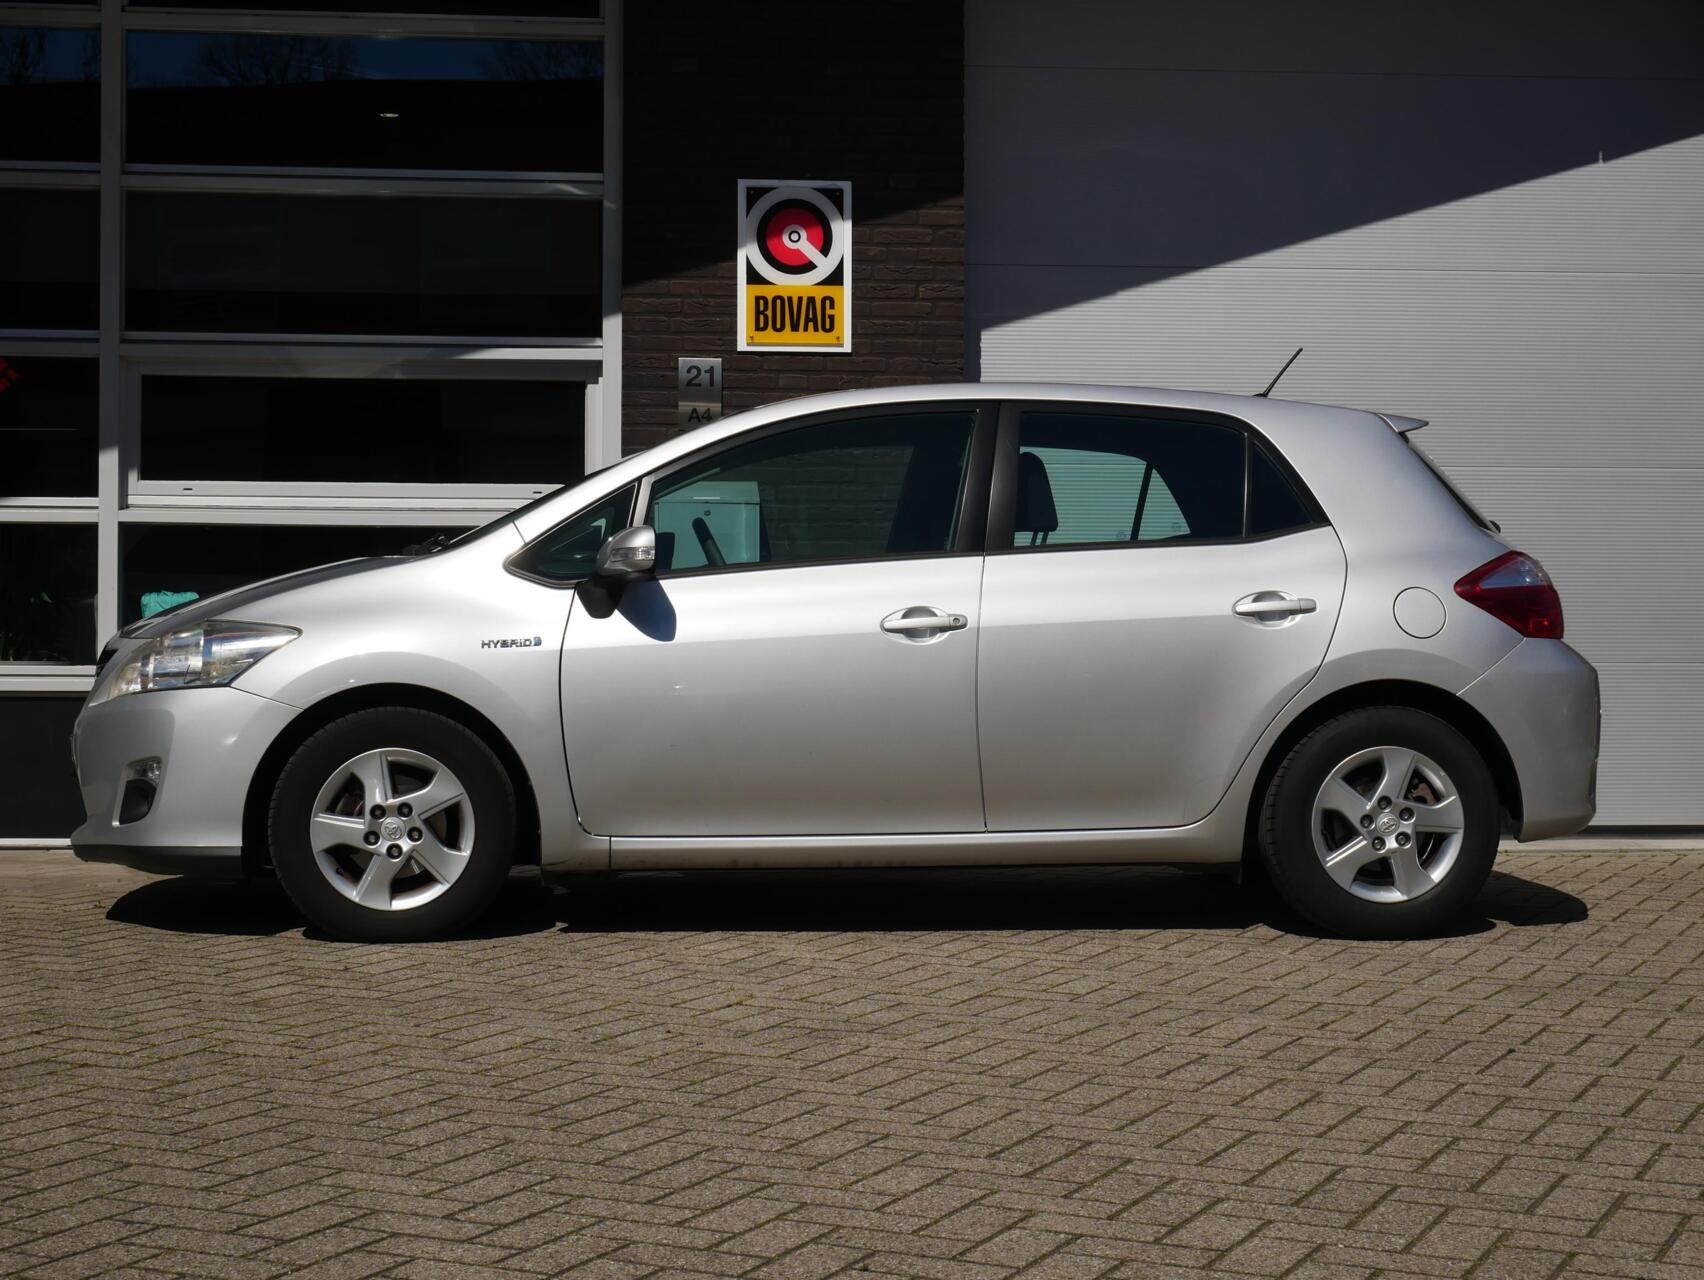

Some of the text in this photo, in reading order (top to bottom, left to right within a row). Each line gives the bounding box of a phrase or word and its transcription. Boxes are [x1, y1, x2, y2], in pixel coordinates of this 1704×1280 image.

[754, 295, 835, 333] BOVAG
[686, 365, 715, 387] 21
[687, 407, 713, 423] A4
[481, 638, 533, 649] HYBRID
